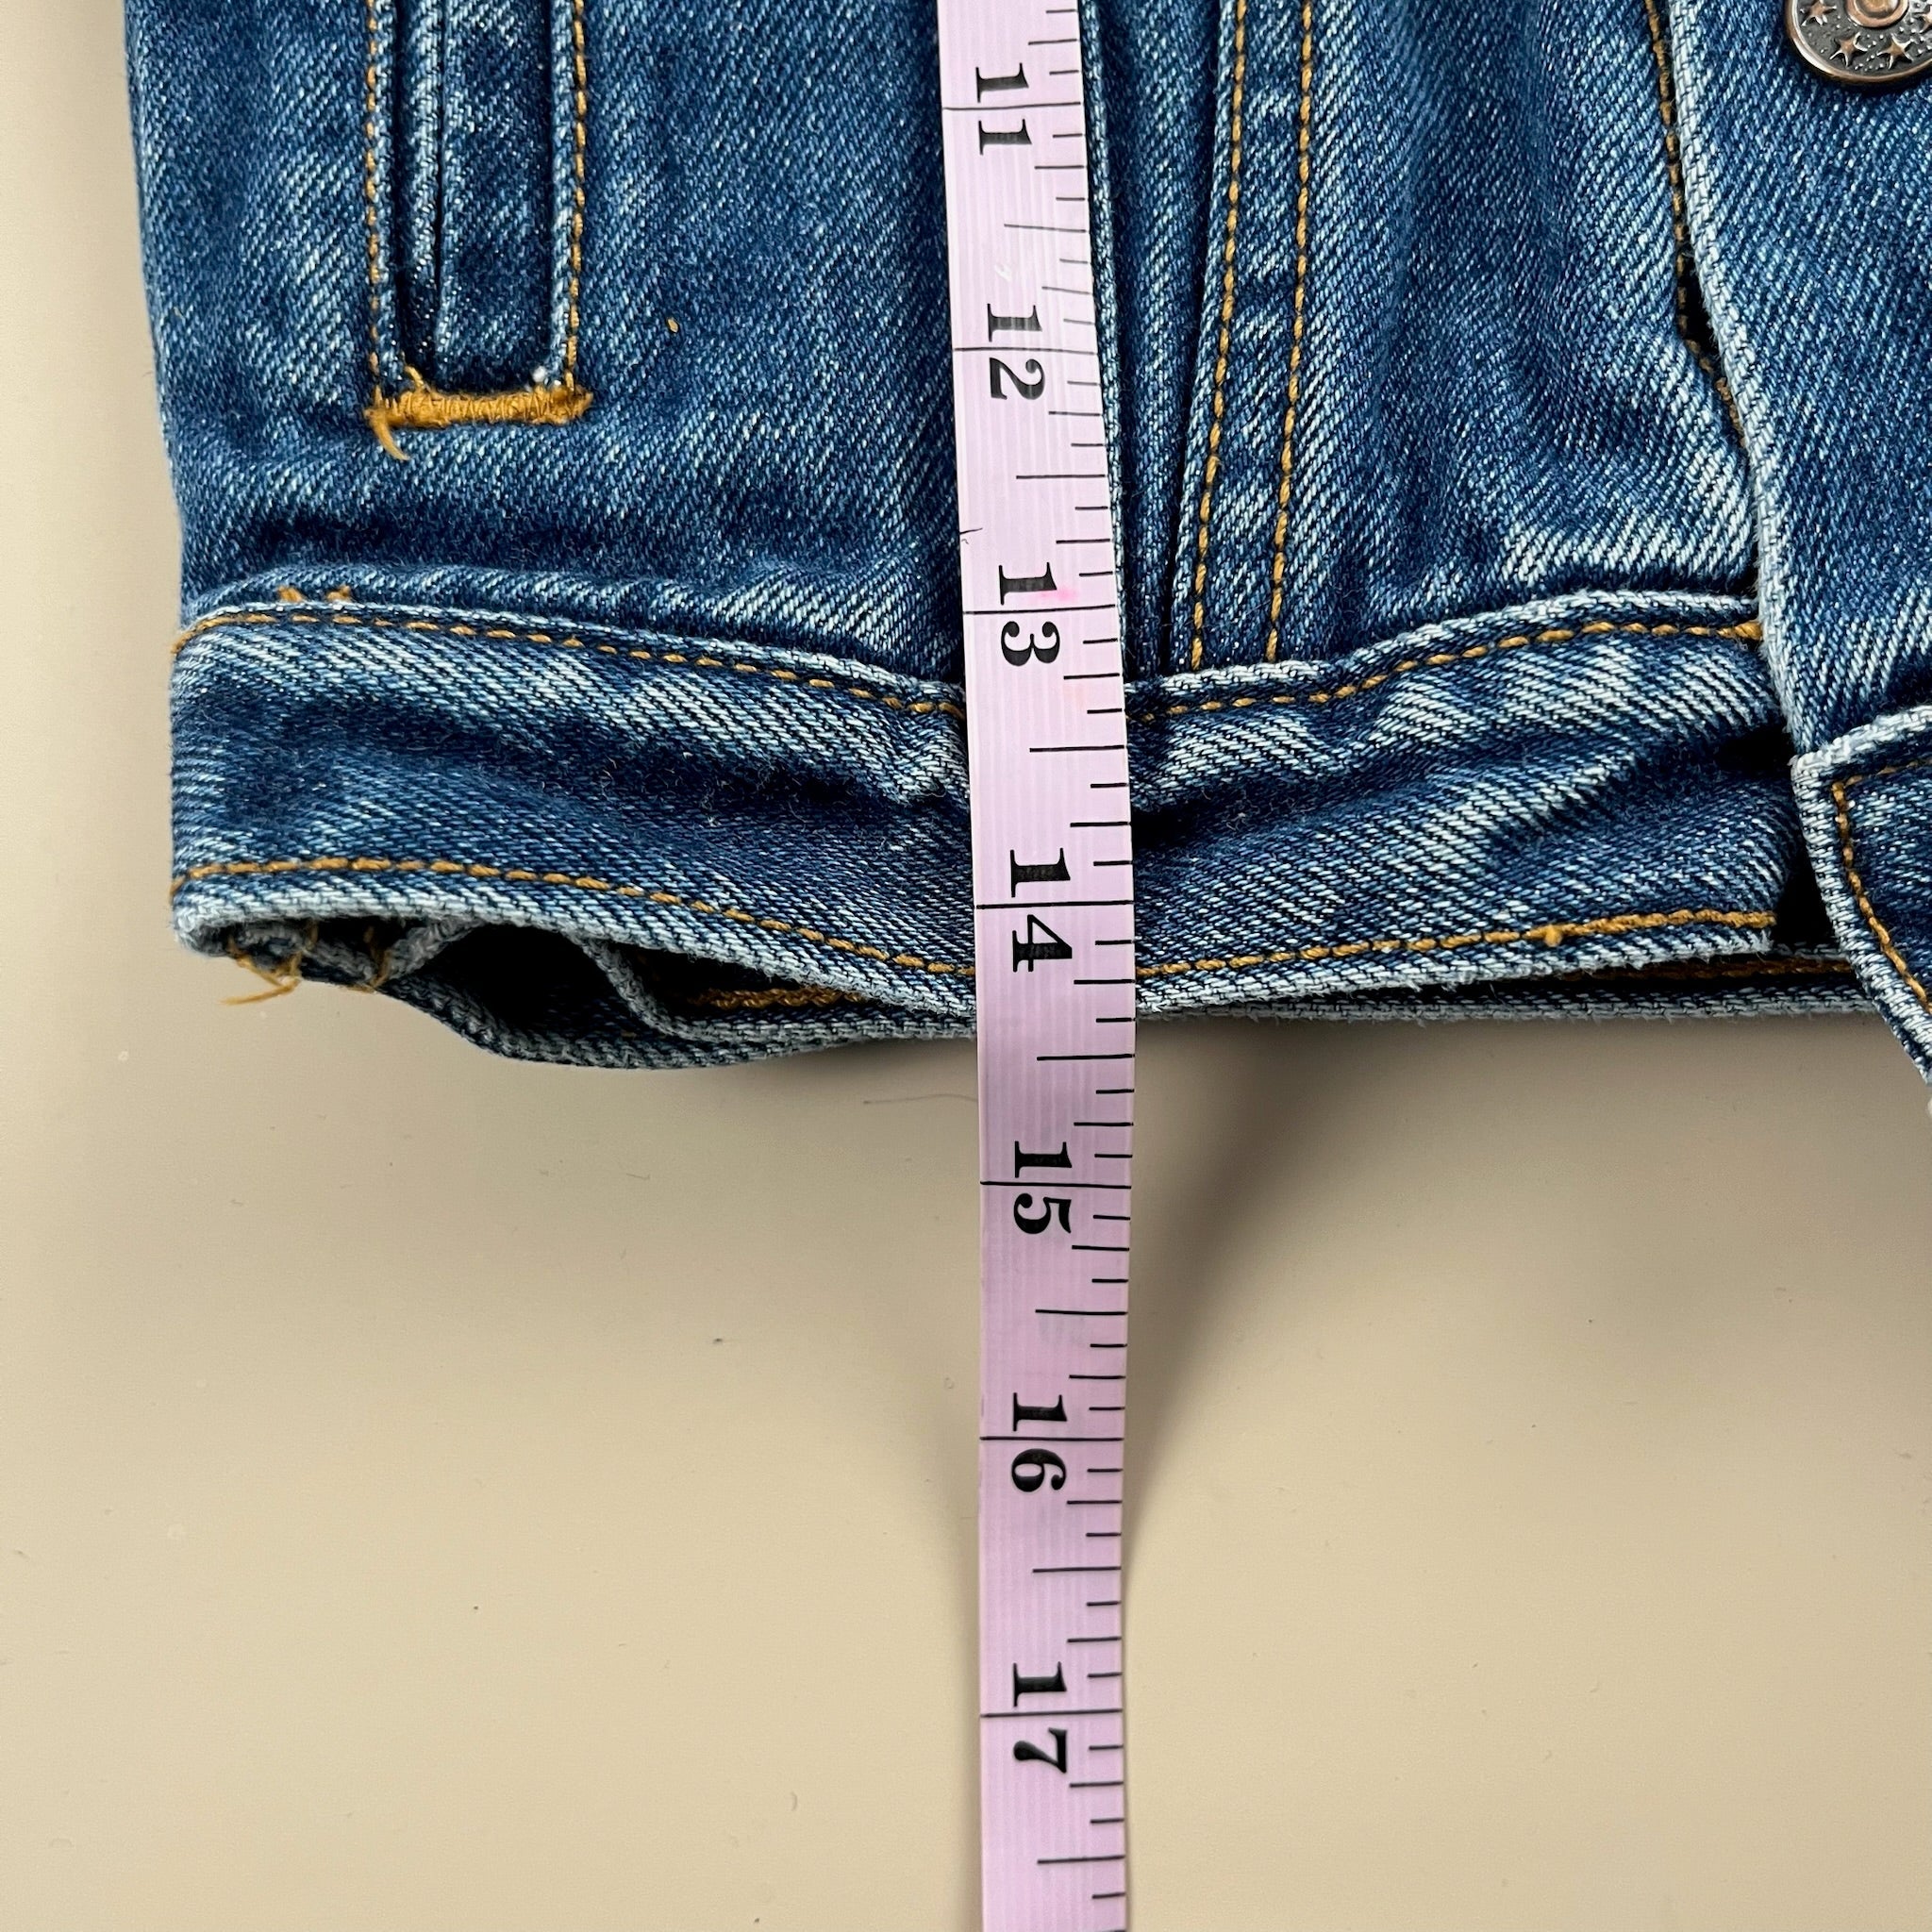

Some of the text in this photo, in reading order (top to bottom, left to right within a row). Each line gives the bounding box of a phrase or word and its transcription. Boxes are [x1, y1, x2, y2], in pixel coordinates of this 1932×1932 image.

[975, 62, 1032, 155] 11
[987, 303, 1046, 400] 12
[998, 561, 1060, 667] 13
[1009, 847, 1073, 973] 14
[1013, 1141, 1074, 1236] 15
[1011, 1392, 1068, 1492] 16
[1013, 1662, 1068, 1774] 17
